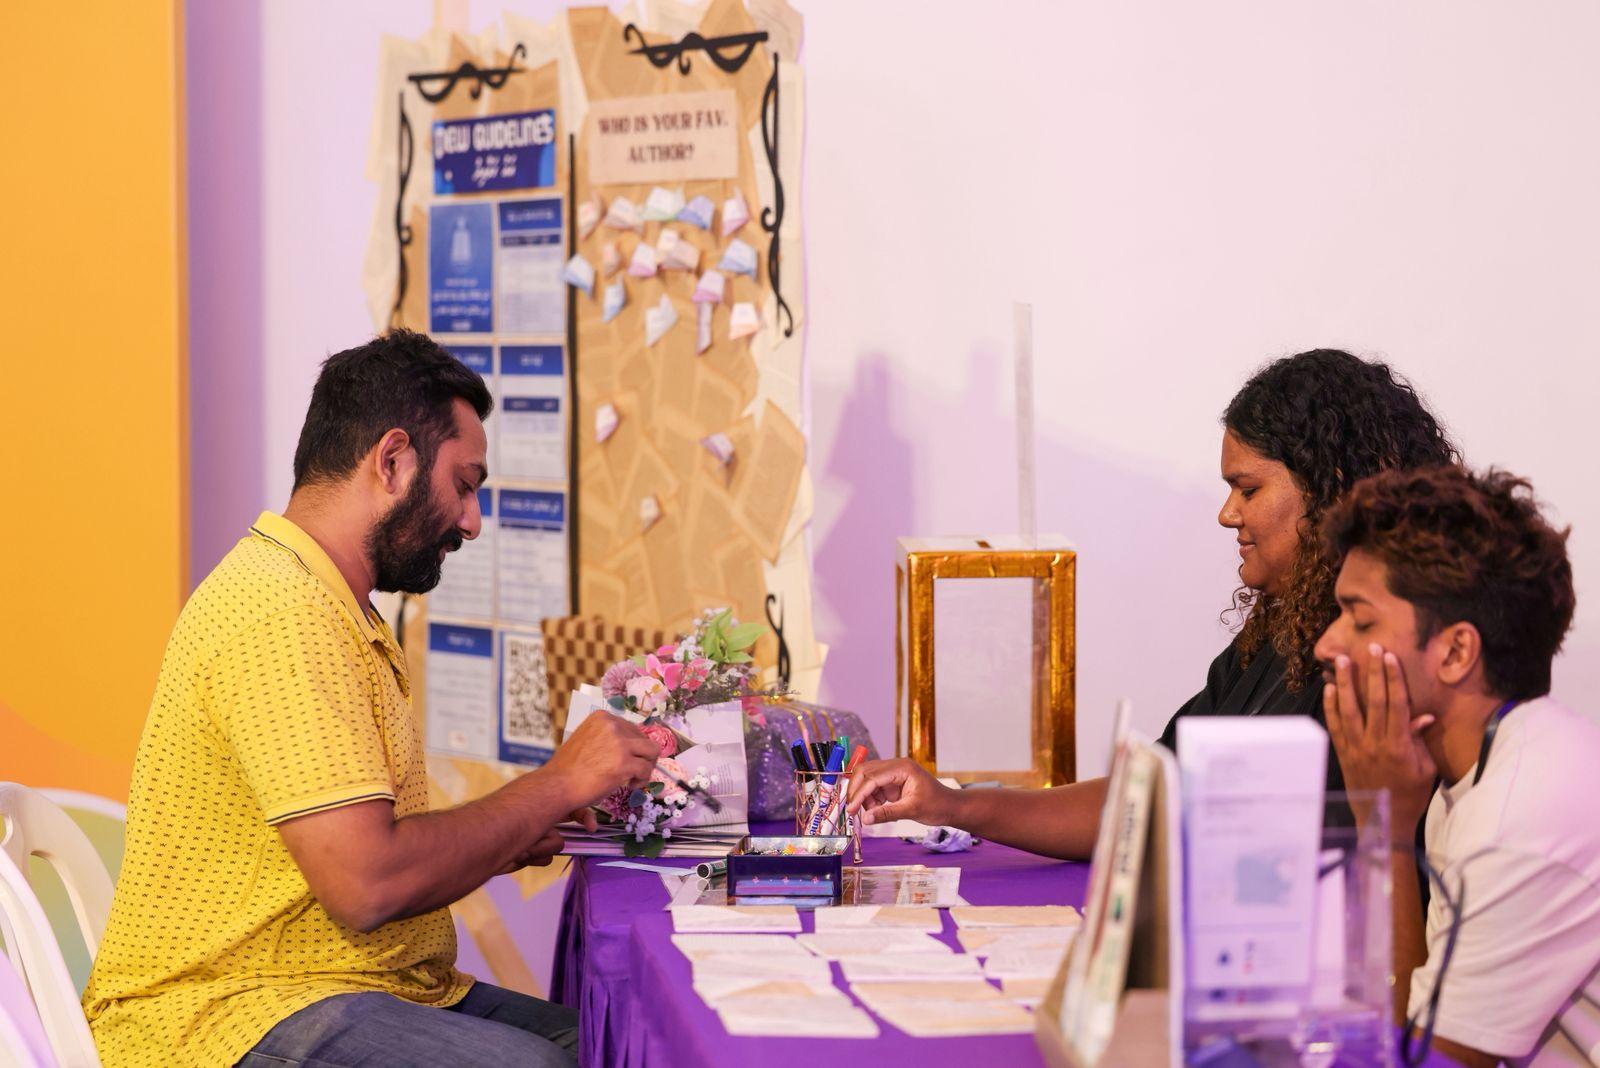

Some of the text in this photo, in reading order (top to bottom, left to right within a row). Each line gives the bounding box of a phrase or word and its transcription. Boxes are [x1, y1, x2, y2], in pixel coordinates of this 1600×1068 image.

[598, 109, 728, 134] WHO IS YOUR FAV.
[628, 142, 695, 163] AUTHOR?
